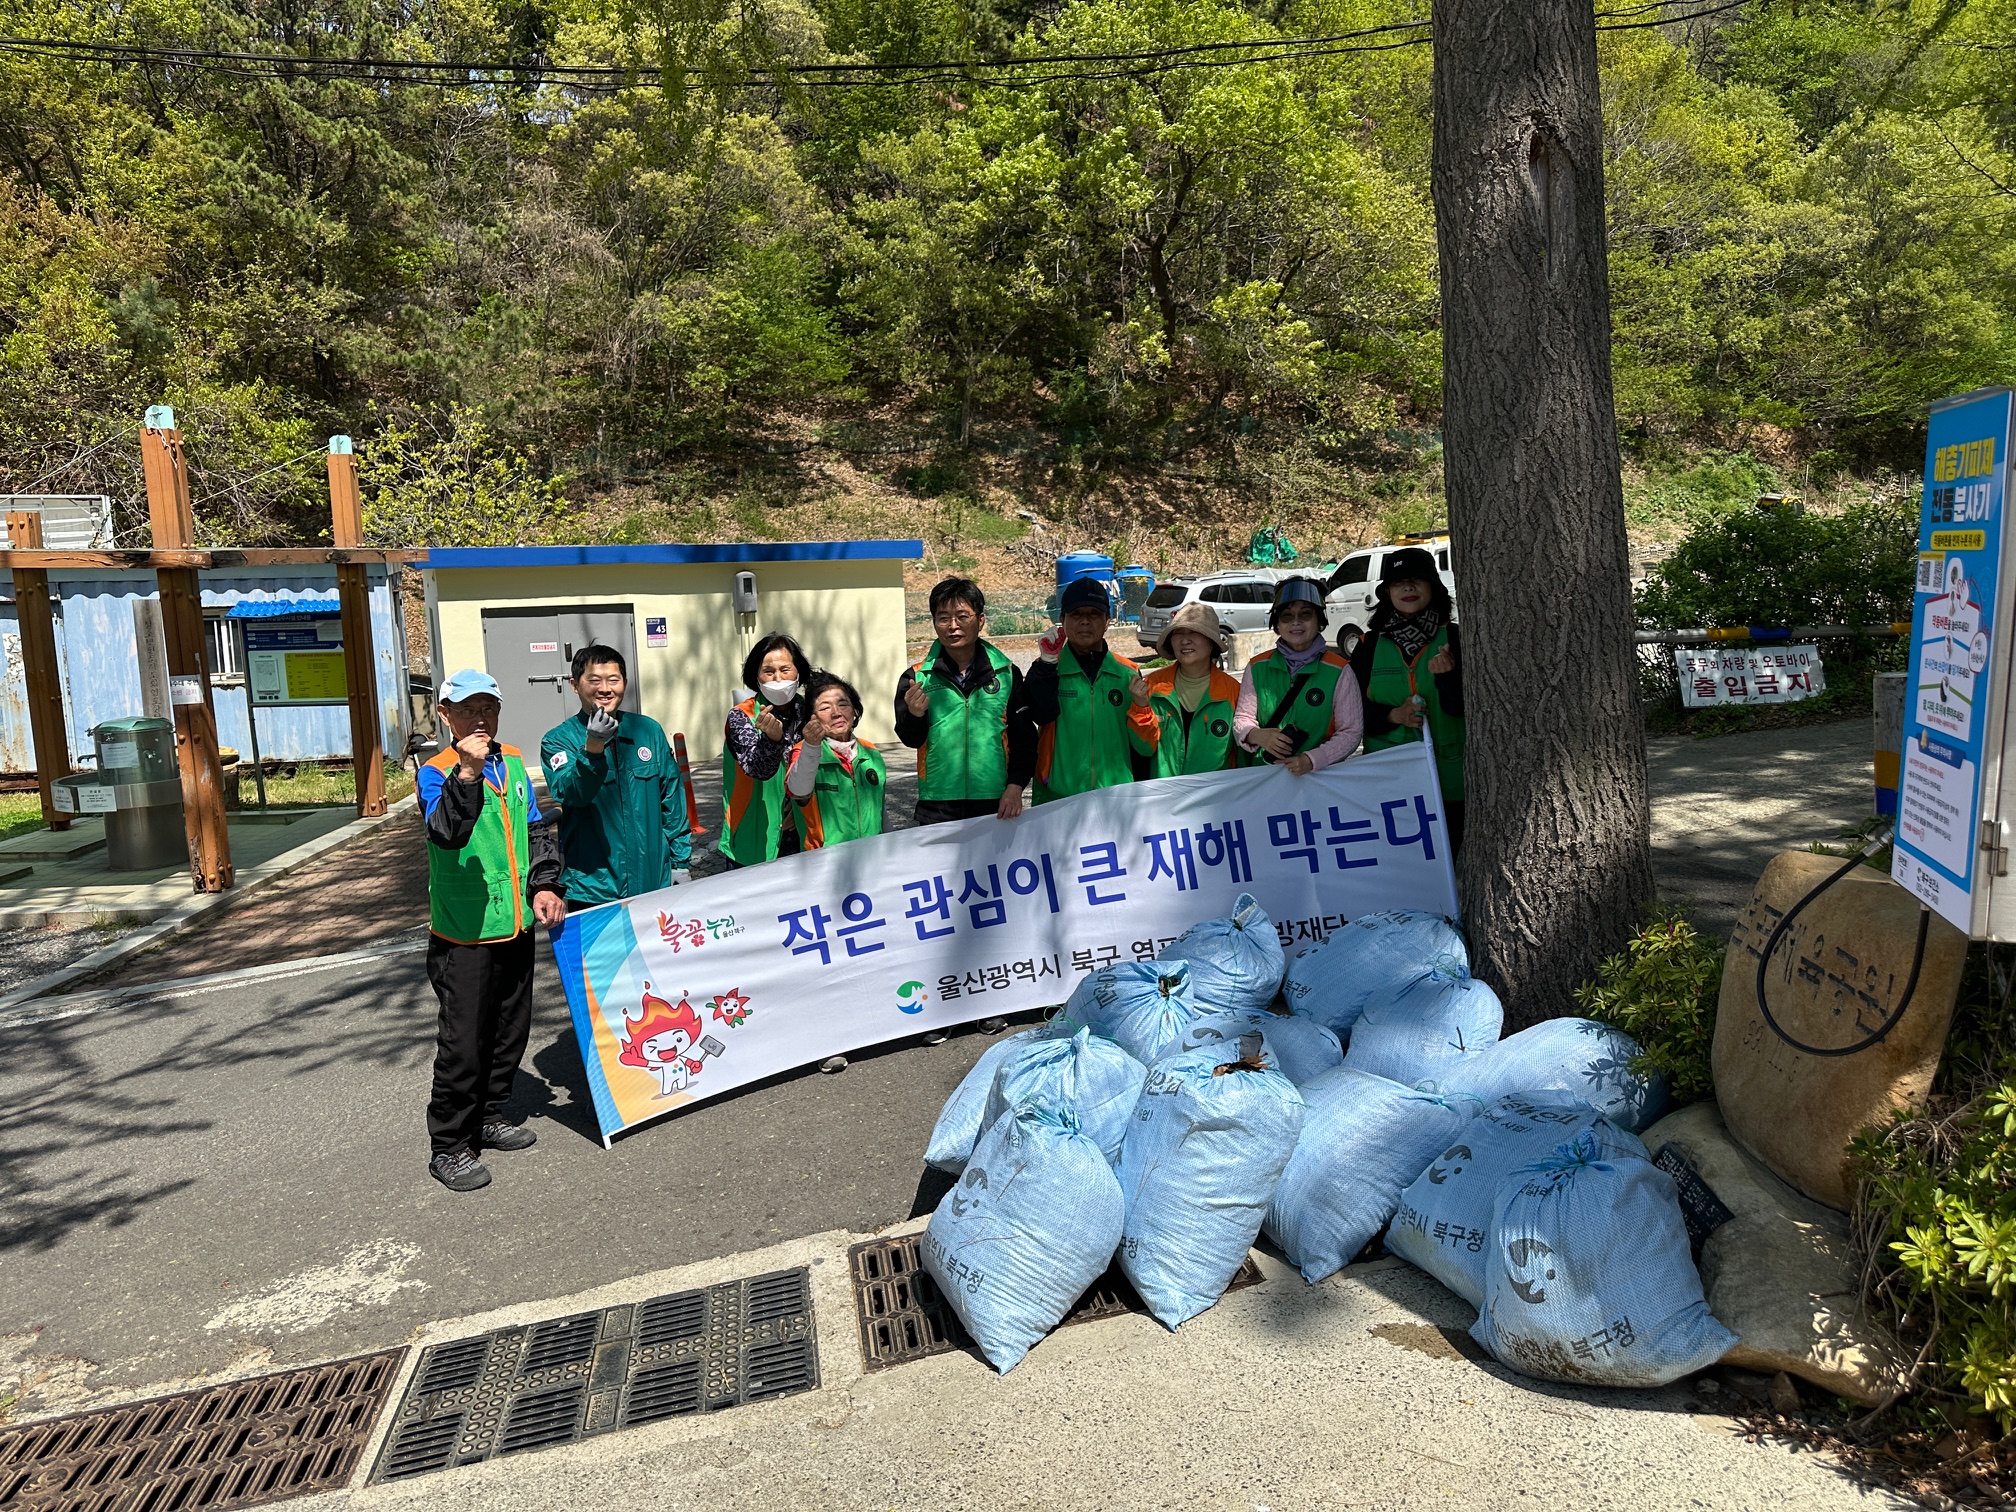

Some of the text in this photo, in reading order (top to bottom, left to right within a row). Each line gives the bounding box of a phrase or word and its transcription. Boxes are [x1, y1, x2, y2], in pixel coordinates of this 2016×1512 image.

[1934, 437, 1996, 482] 해충기피제
[1931, 483, 1991, 523] 전동분사기
[656, 625, 666, 633] 43
[1722, 656, 1745, 671] 차량
[1748, 658, 1759, 669] 및
[1763, 653, 1811, 668] 오토바이
[1693, 672, 1812, 698] 출입금지
[777, 794, 1438, 967] 작은 관심이 큰 재해 막는다
[936, 953, 1064, 1002] 울산광역시
[1071, 945, 1121, 974] 북구
[1433, 1220, 1486, 1253] 북구청
[946, 1252, 986, 1295] 북구청
[1570, 1315, 1636, 1361] 북구청
